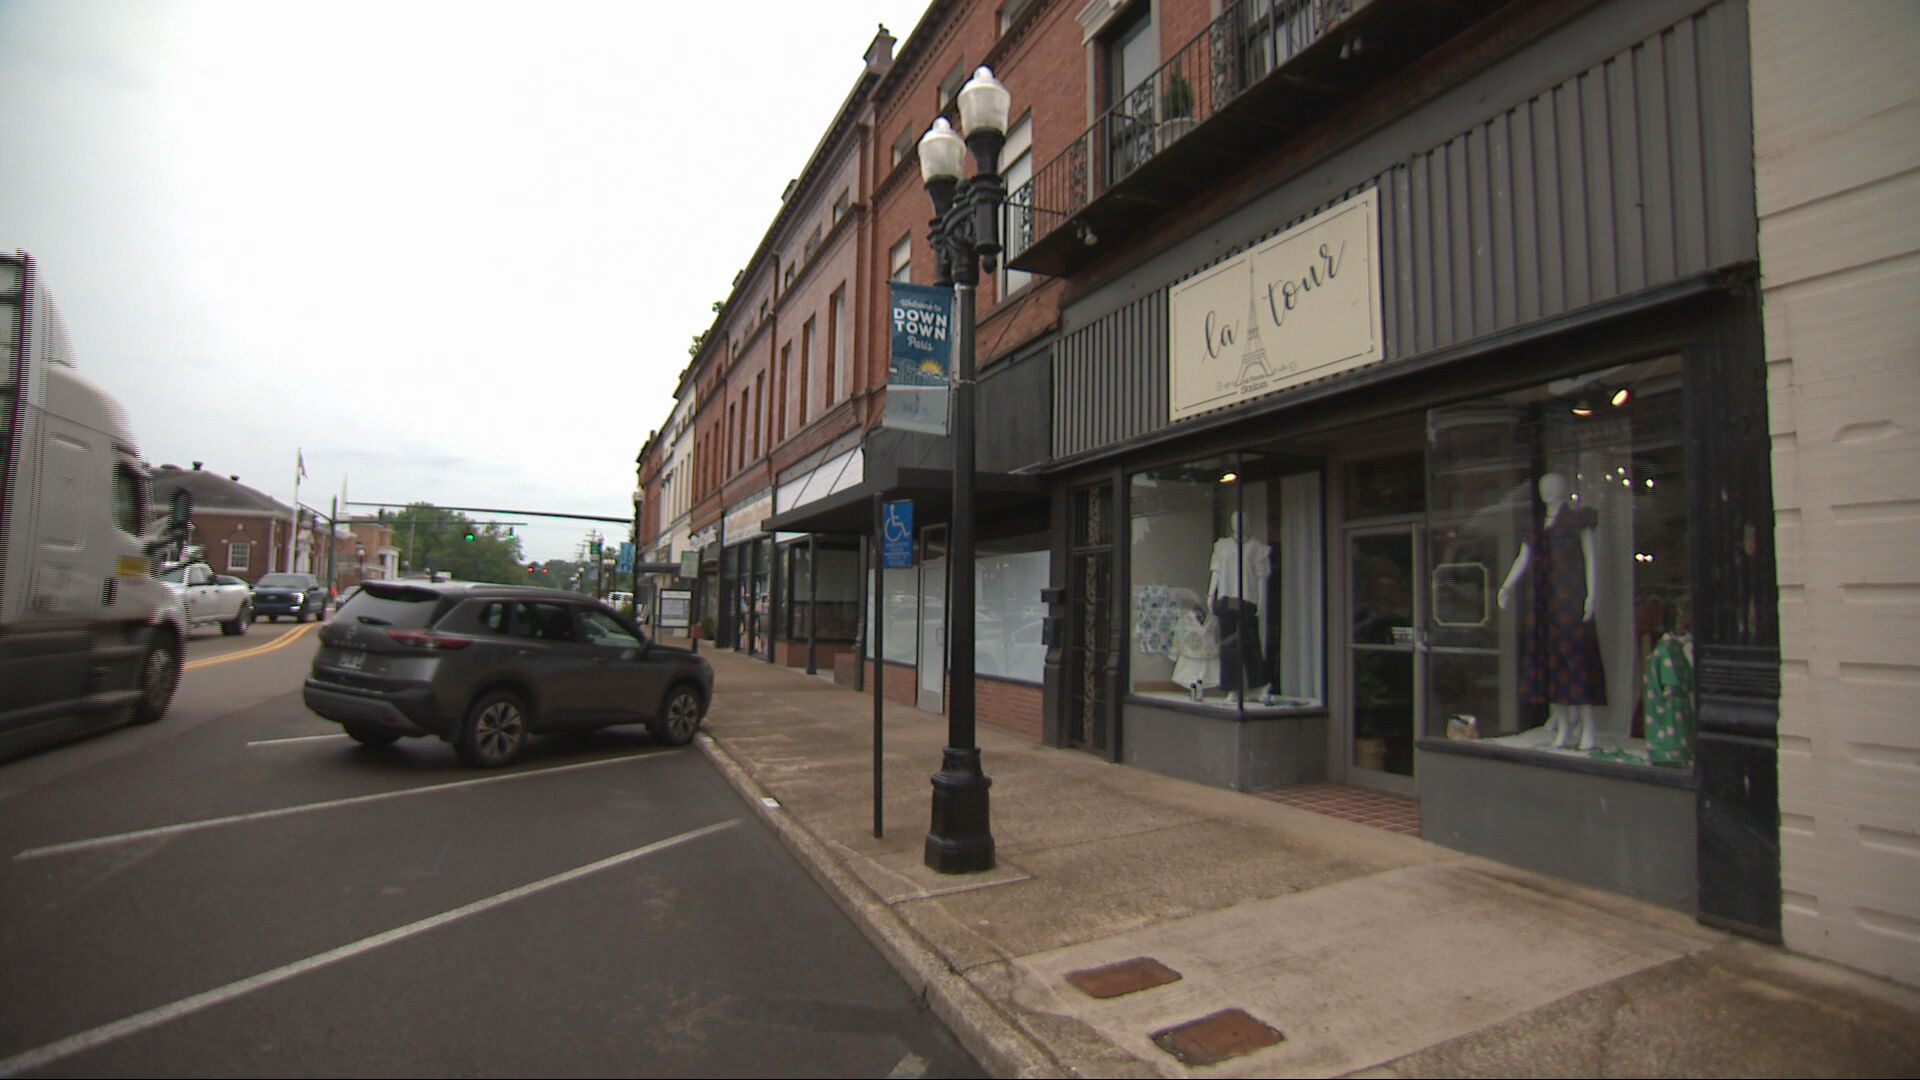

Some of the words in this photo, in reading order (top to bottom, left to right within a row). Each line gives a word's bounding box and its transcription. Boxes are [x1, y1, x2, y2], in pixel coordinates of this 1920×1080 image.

[1201, 310, 1238, 362] la
[1262, 240, 1345, 327] tour
[893, 307, 947, 328] DOWN
[894, 320, 946, 340] TOWN
[907, 335, 934, 352] Paris
